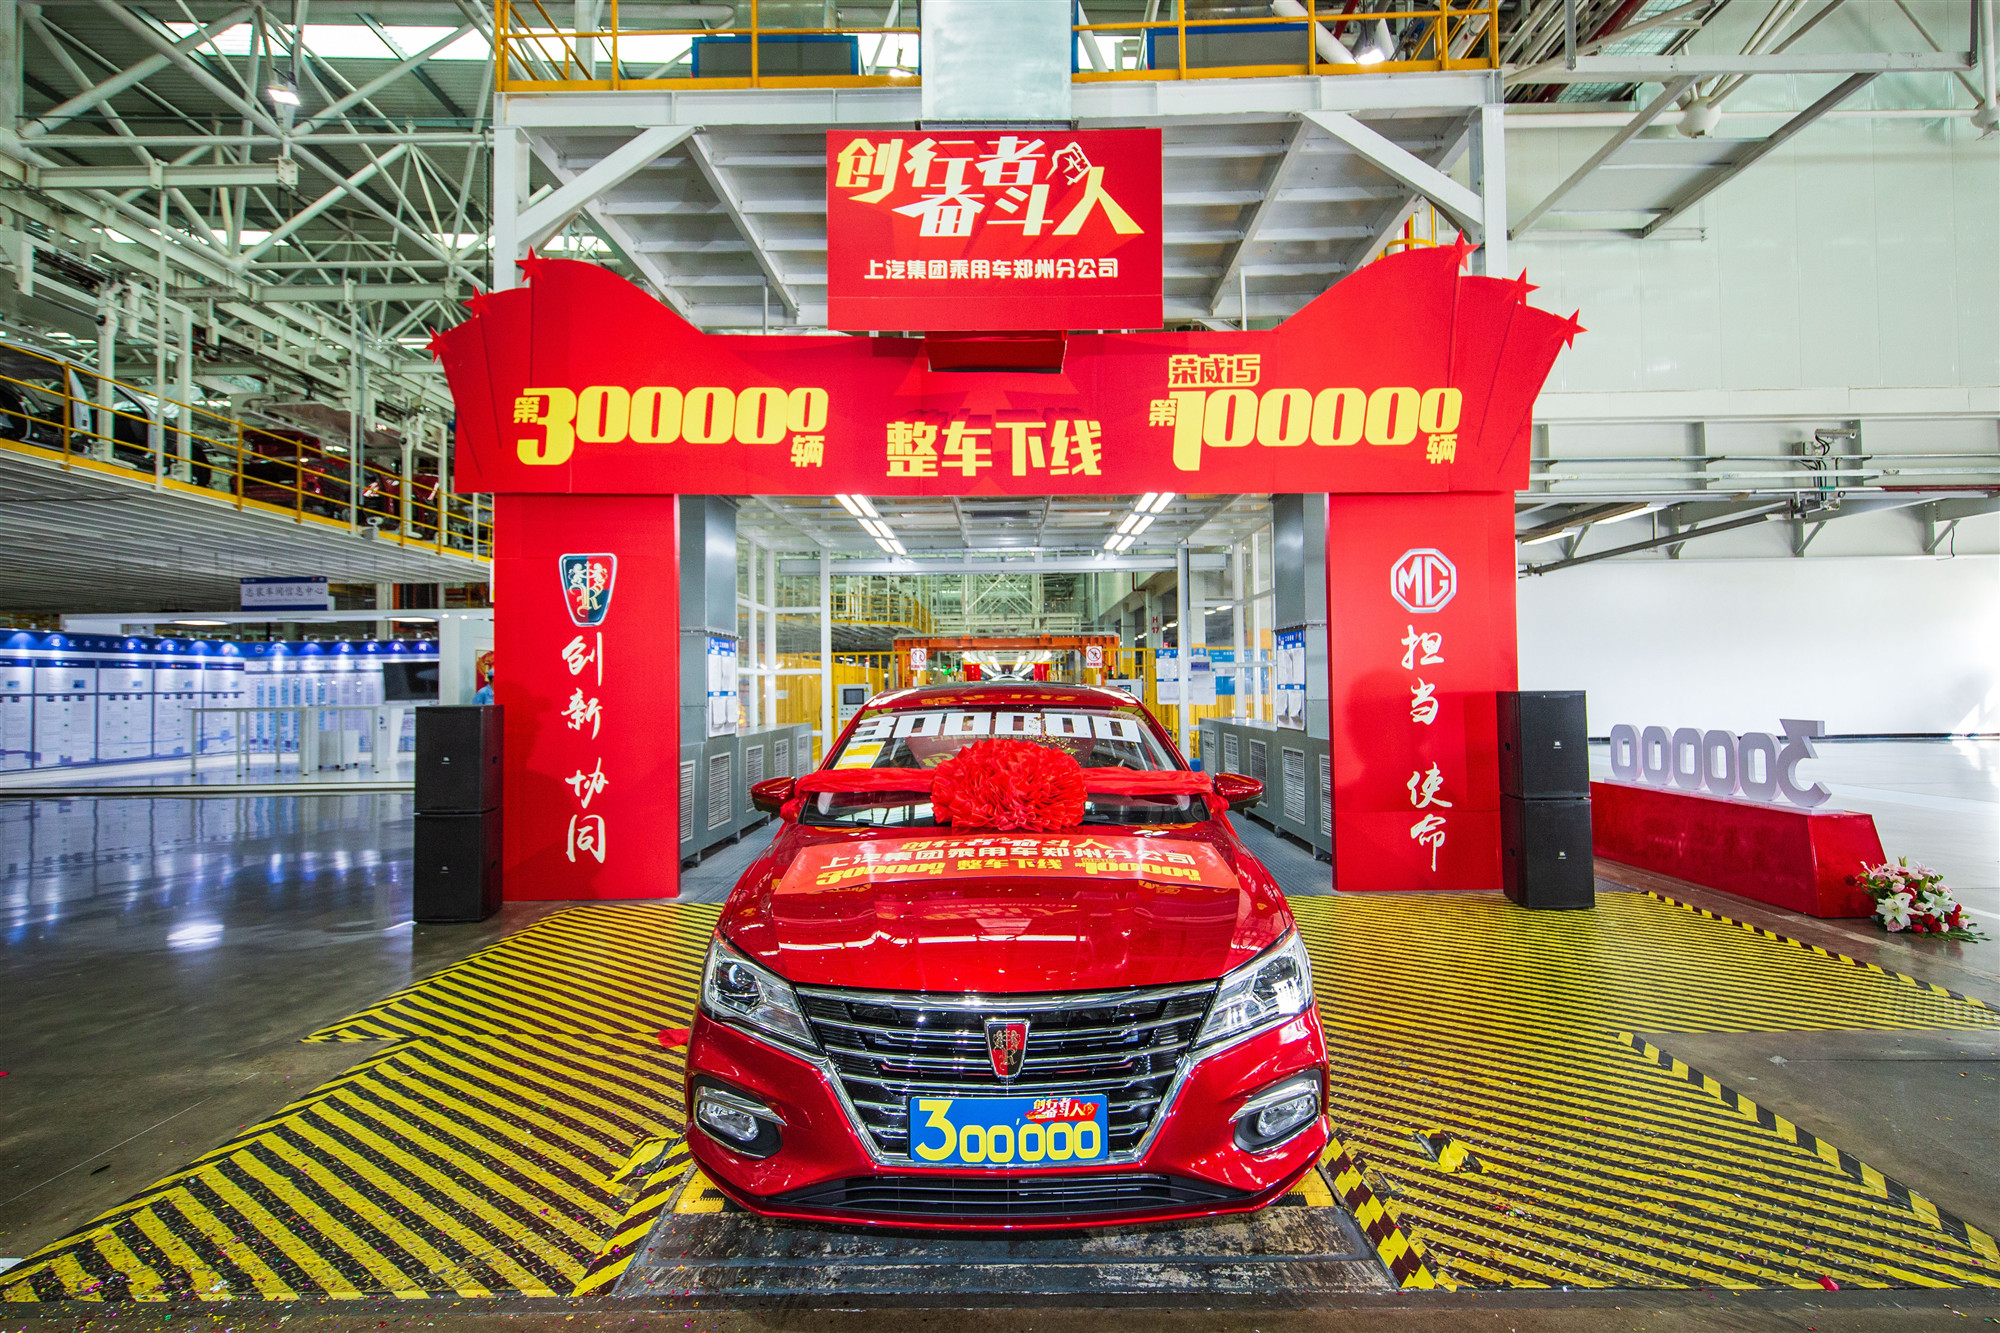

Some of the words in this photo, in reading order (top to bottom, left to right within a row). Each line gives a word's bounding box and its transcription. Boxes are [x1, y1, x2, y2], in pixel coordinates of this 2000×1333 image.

[835, 136, 1046, 204] 创行者
[892, 165, 1145, 237] 奋斗人
[864, 259, 1119, 280] 上汽集团乘用车郑州分公司
[886, 420, 1102, 477] 整车下线
[1398, 556, 1450, 607] MG
[561, 632, 603, 740] 创新
[1401, 624, 1445, 725] 担当
[850, 711, 1142, 743] 300000
[565, 757, 609, 864] 协同
[1406, 761, 1453, 872] 使命
[820, 847, 1197, 869] 上汽集团乘用车郑州分公司
[957, 858, 1063, 871] 整车下线
